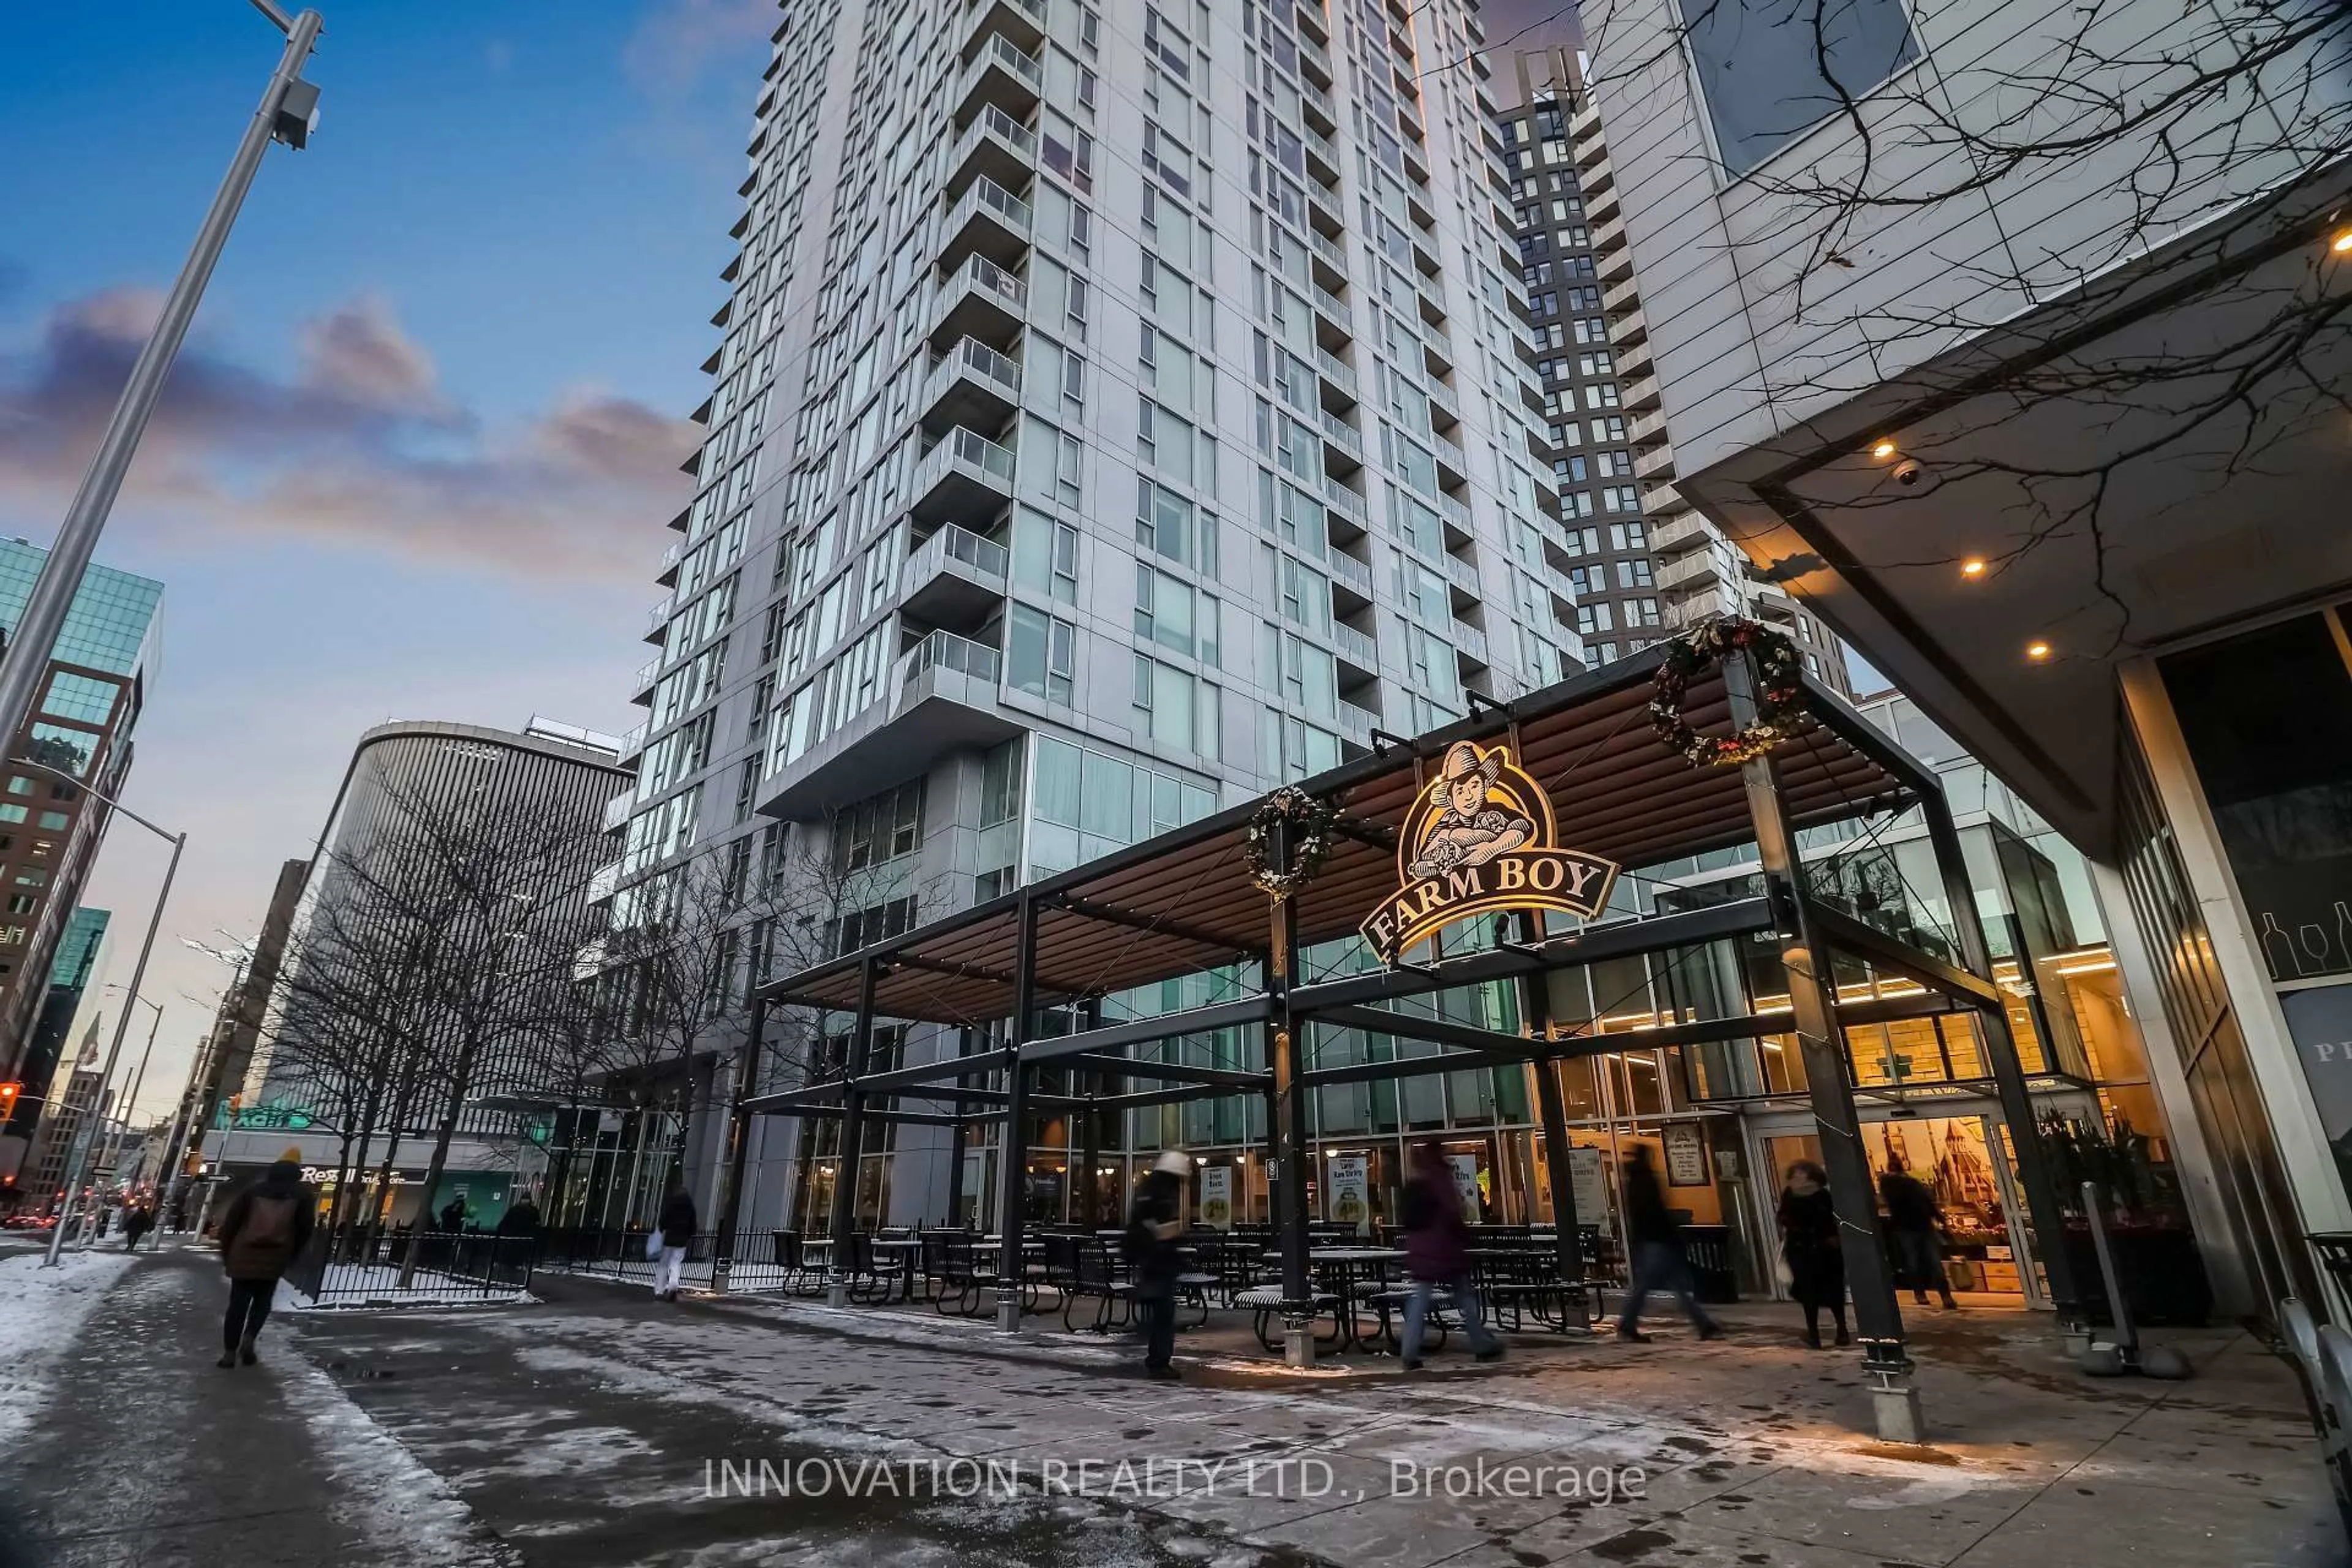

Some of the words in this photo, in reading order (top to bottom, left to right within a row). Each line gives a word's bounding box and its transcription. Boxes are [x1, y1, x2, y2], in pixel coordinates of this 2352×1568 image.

[1370, 867, 1485, 949] FARM
[1496, 857, 1602, 898] BOY
[299, 1166, 356, 1184] Rexll
